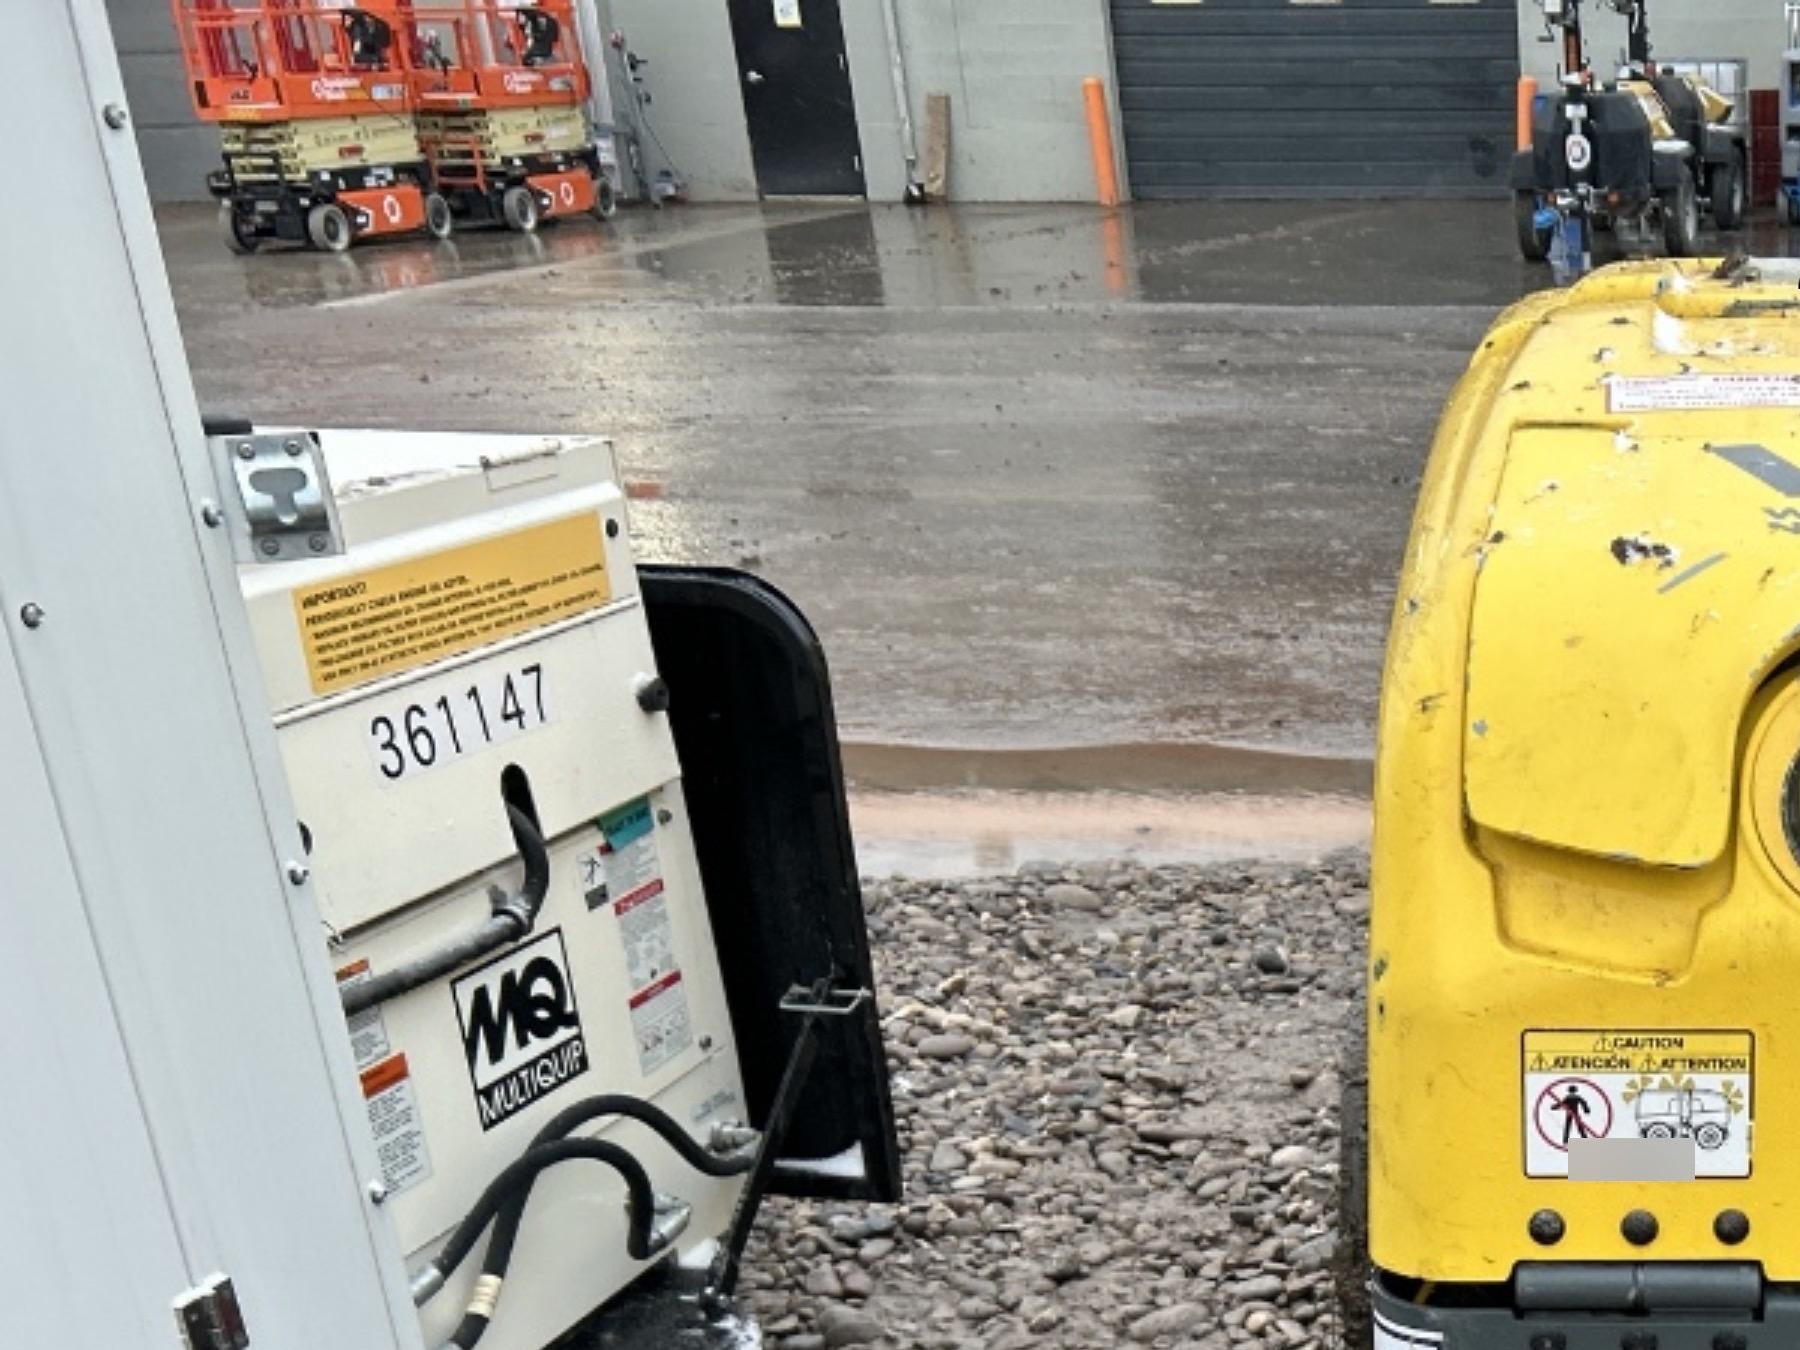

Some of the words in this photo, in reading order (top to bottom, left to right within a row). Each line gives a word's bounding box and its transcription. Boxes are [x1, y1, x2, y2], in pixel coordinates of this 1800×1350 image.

[371, 663, 546, 779] 361147
[466, 956, 578, 1078] MQ
[1613, 1037, 1684, 1050] CAUTION
[478, 1040, 583, 1123] MULTIQUIP
[1661, 1057, 1746, 1069] ATTENTION
